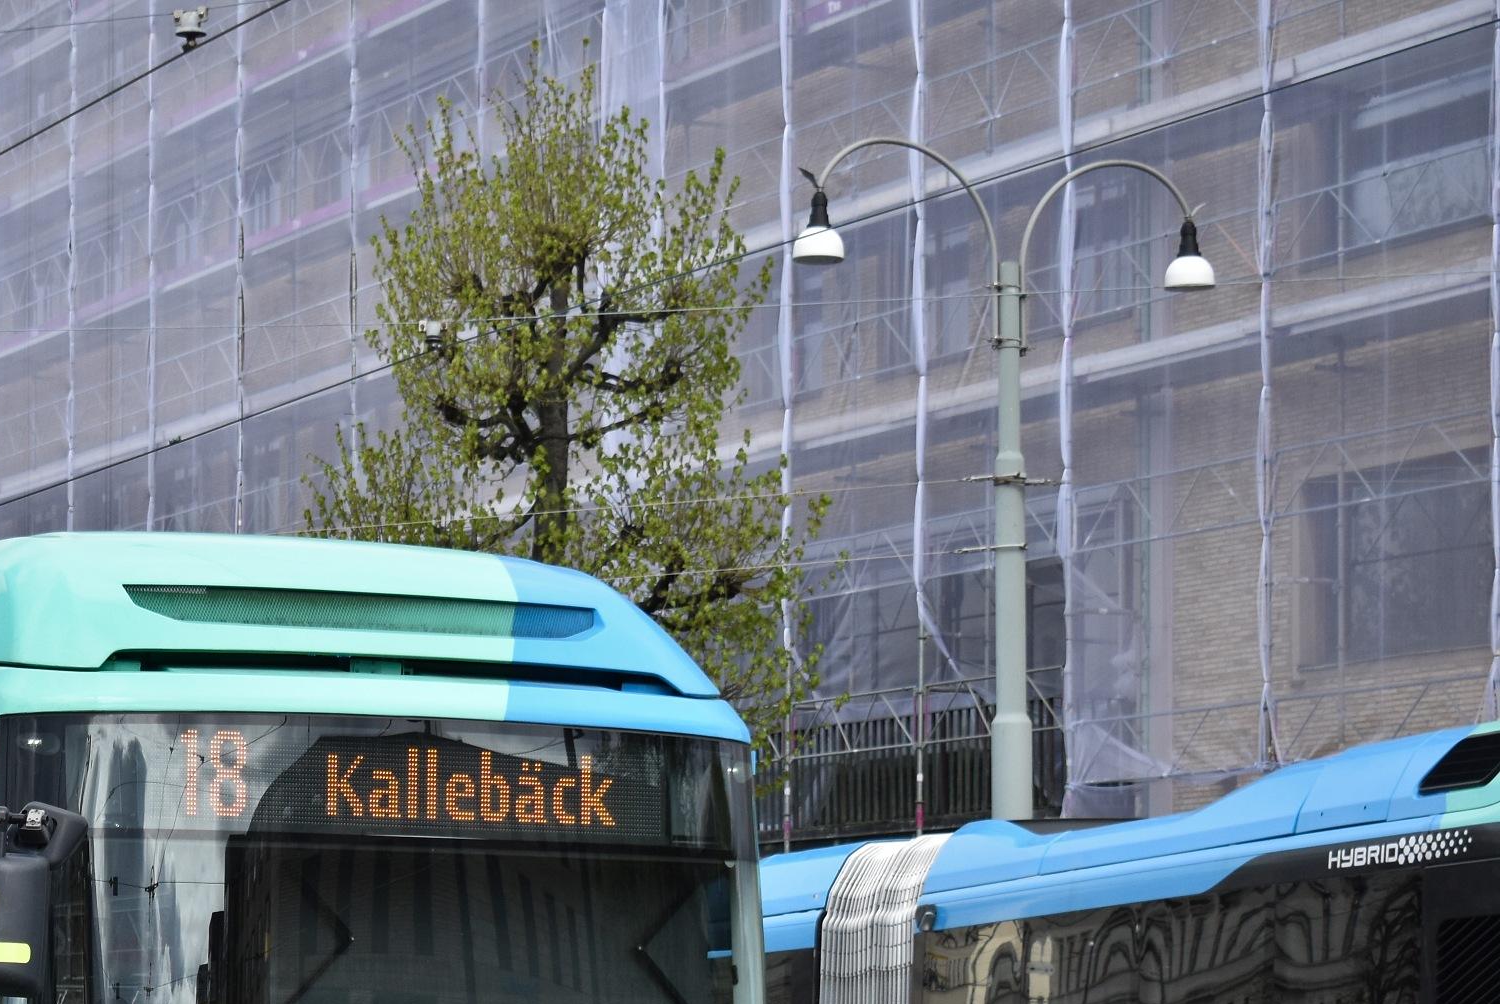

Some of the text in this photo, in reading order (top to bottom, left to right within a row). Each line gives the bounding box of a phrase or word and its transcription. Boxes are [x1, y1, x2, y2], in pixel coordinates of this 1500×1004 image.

[181, 729, 616, 826] 18 Kallebäck
[1328, 843, 1399, 870] HYBRID
